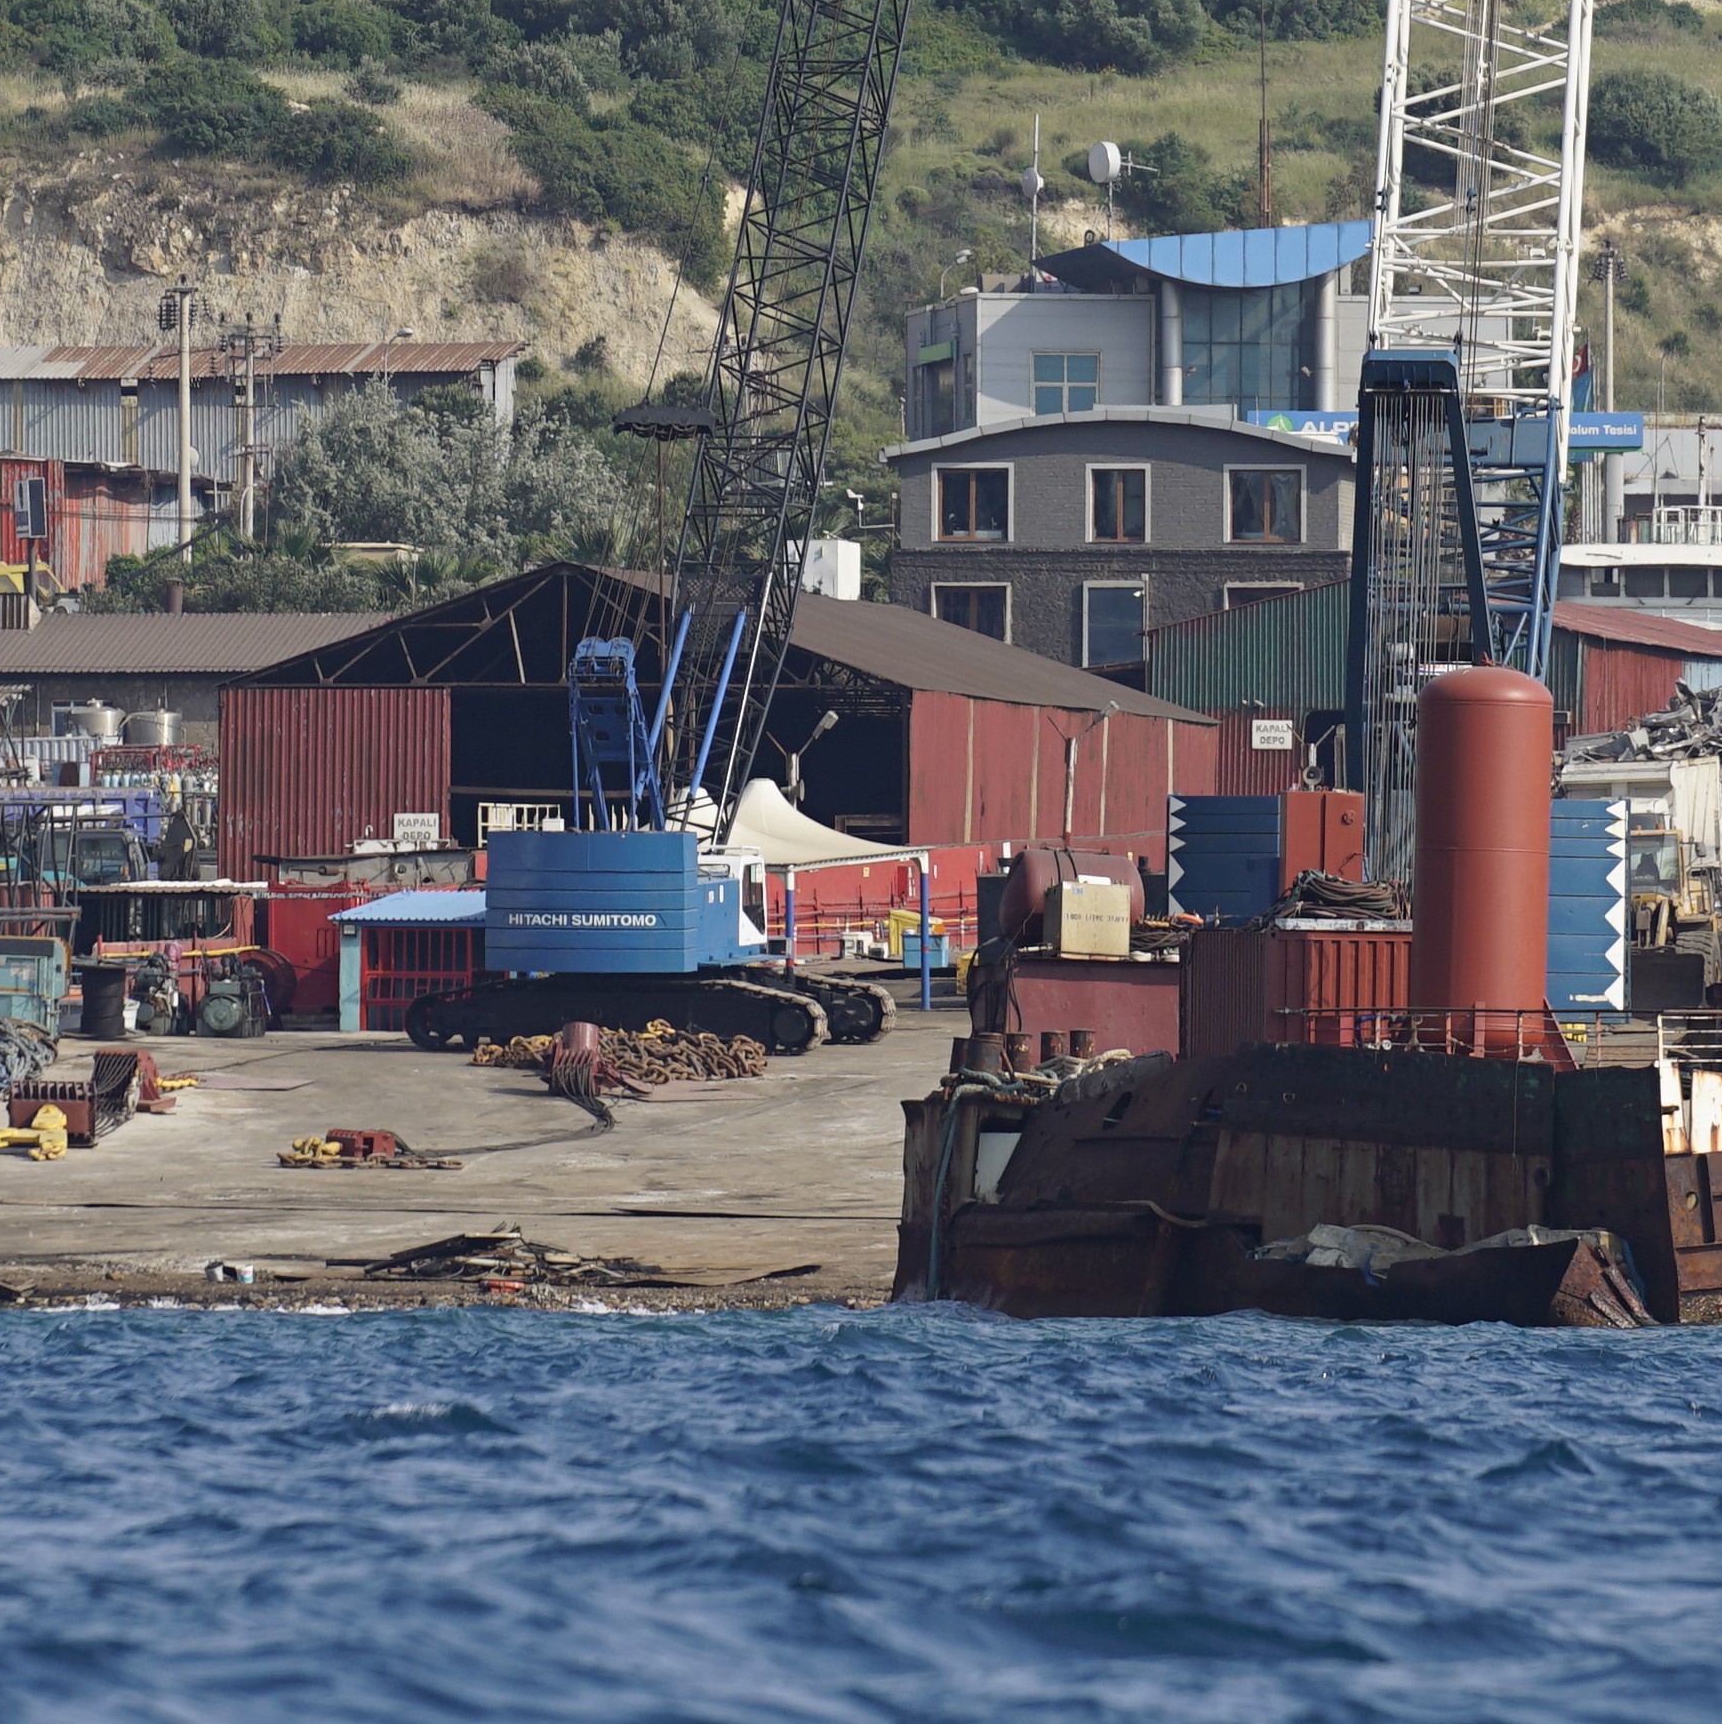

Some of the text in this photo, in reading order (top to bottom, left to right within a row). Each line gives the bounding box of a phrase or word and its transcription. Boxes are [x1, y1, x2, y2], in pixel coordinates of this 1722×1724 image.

[1569, 424, 1637, 435] olum Tesisi
[1259, 736, 1285, 745] DEPO
[397, 818, 437, 827] KAPALI
[402, 831, 431, 840] DEPO
[508, 913, 656, 926] HITACHI SUMITOMO
